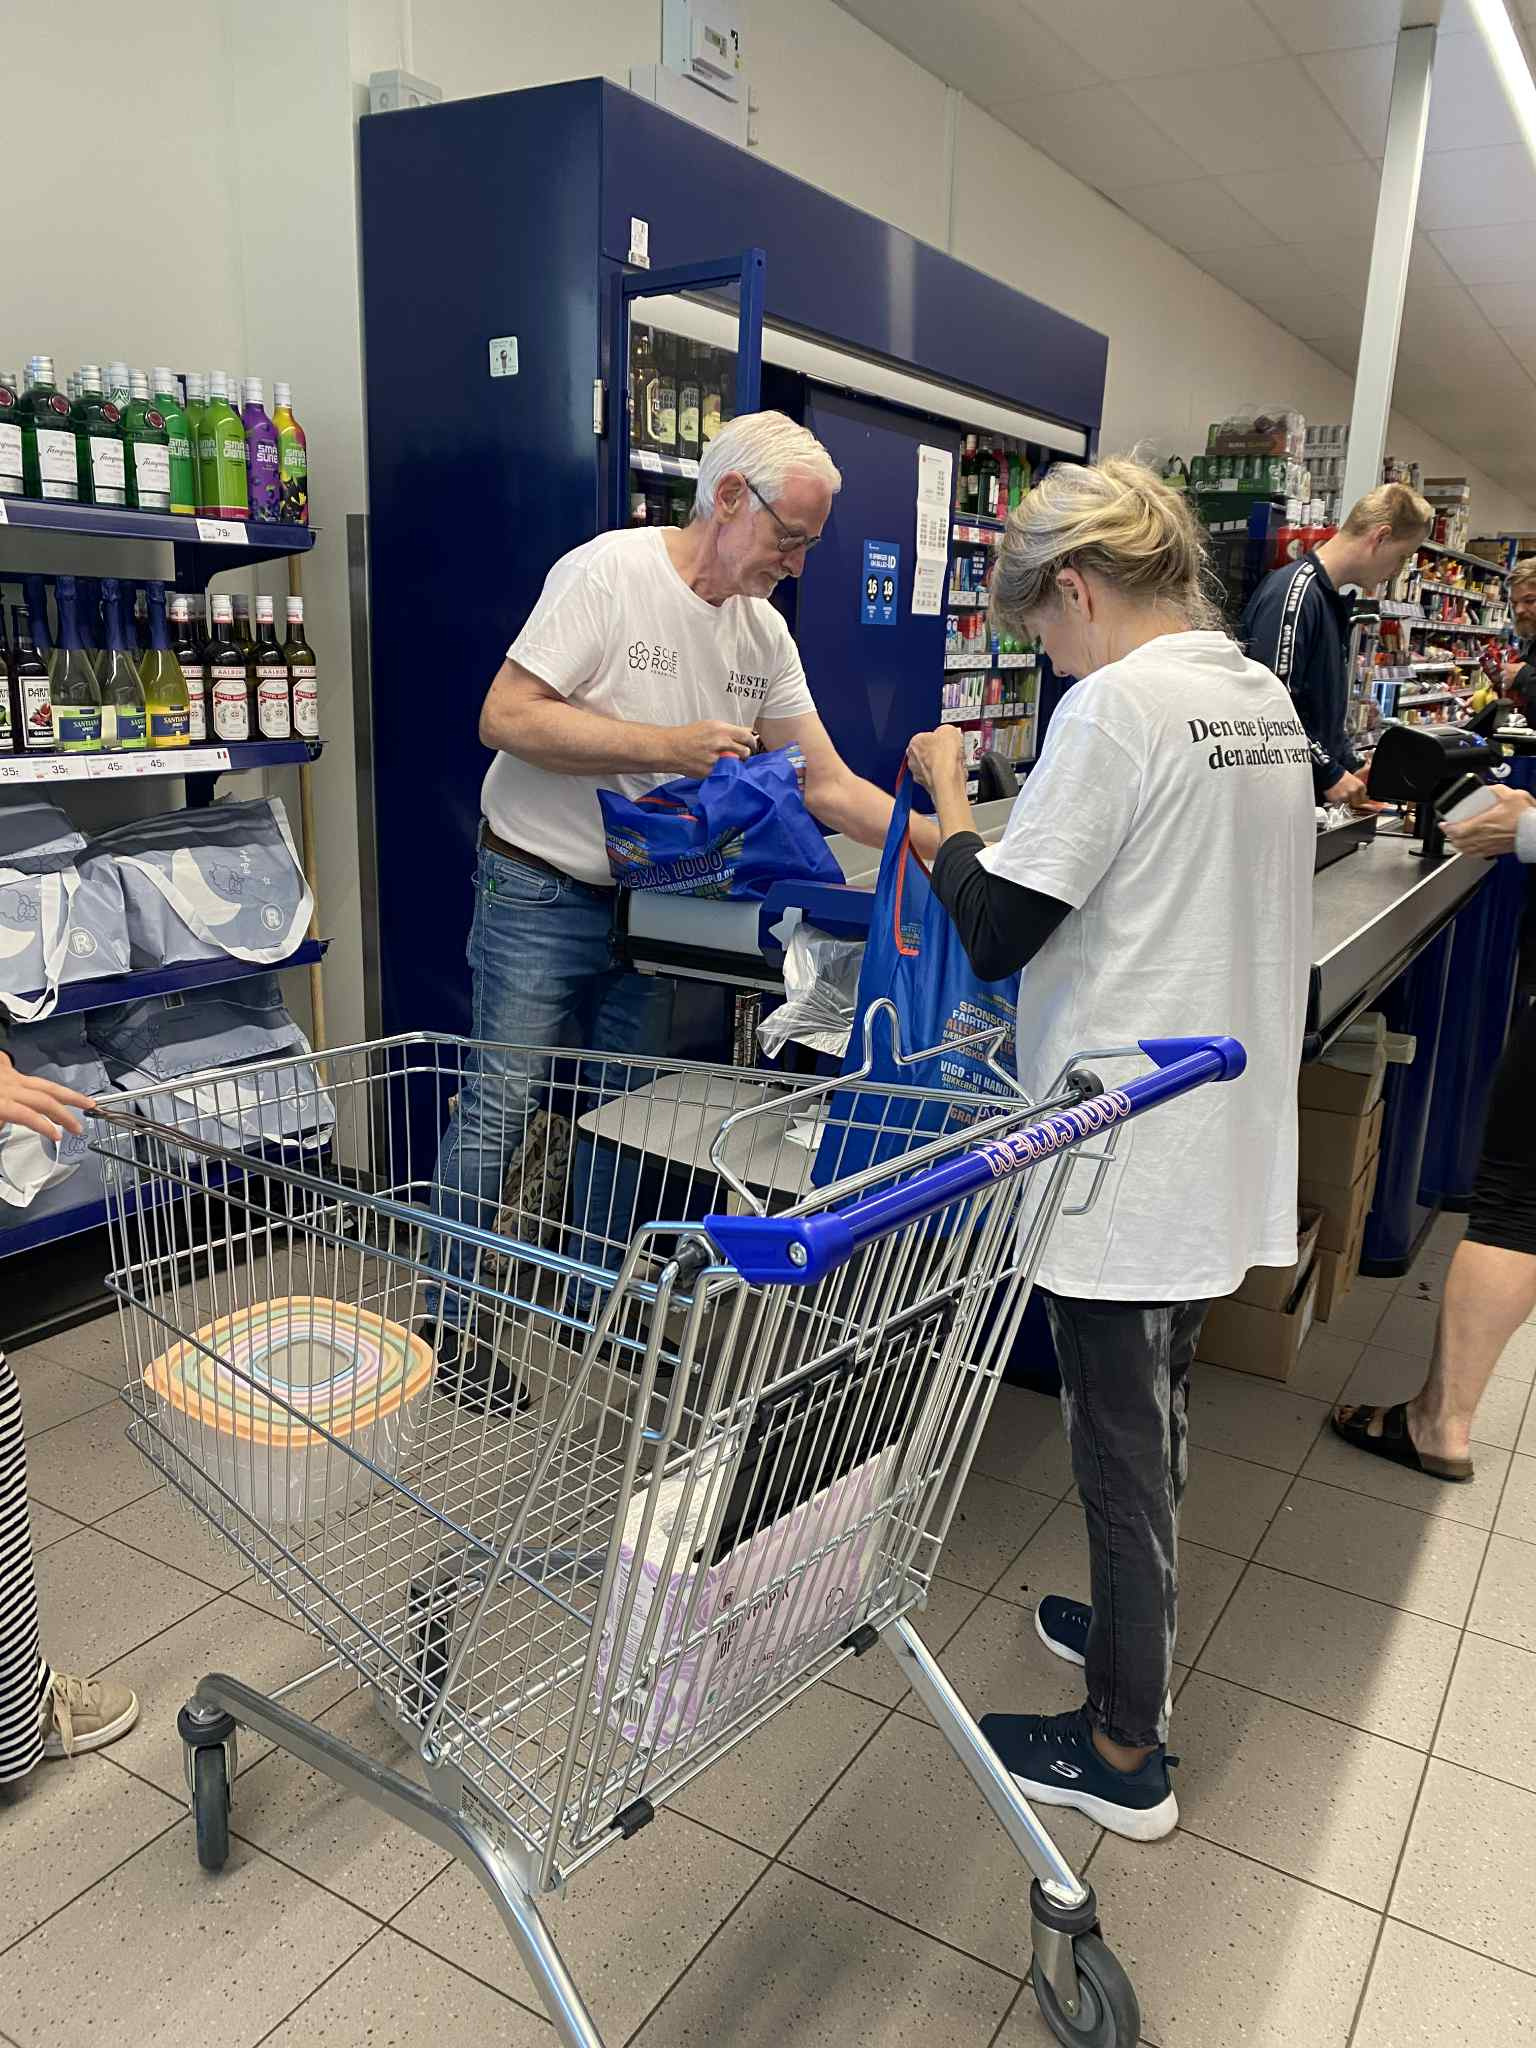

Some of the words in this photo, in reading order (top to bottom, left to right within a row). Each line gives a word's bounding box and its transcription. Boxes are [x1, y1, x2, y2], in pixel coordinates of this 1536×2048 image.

[867, 578, 878, 595] 16
[883, 580, 893, 596] 18
[651, 657, 677, 673] ROSE
[1186, 718, 1233, 744] Den
[1233, 719, 1257, 737] ene
[1257, 716, 1306, 742] tjeneste
[1208, 744, 1245, 770] den
[1245, 742, 1284, 766] anden
[952, 1009, 993, 1031] FAIRTRA
[974, 1110, 1075, 1177] REMA
[1070, 1089, 1132, 1137] 1000
